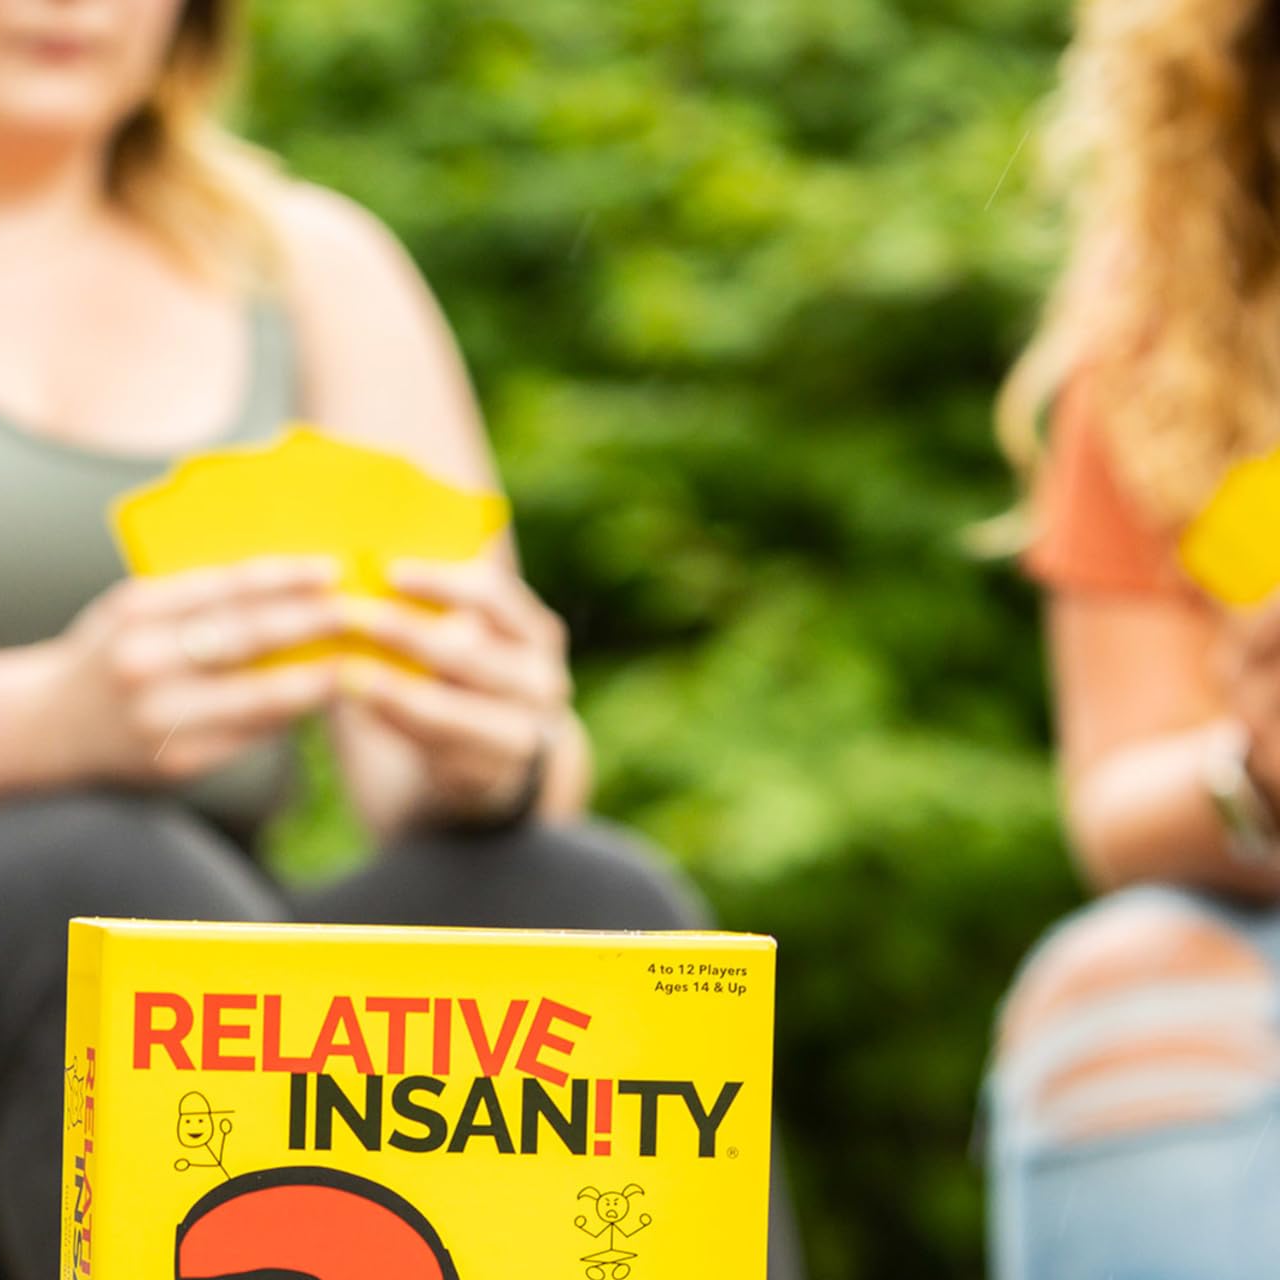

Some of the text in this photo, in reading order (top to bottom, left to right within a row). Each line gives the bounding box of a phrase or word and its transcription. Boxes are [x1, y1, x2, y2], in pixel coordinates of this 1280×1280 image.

[647, 963, 748, 979] 4 to 12 Players
[655, 981, 747, 996] Ages 14 & Up
[132, 991, 593, 1089] RELATIVE
